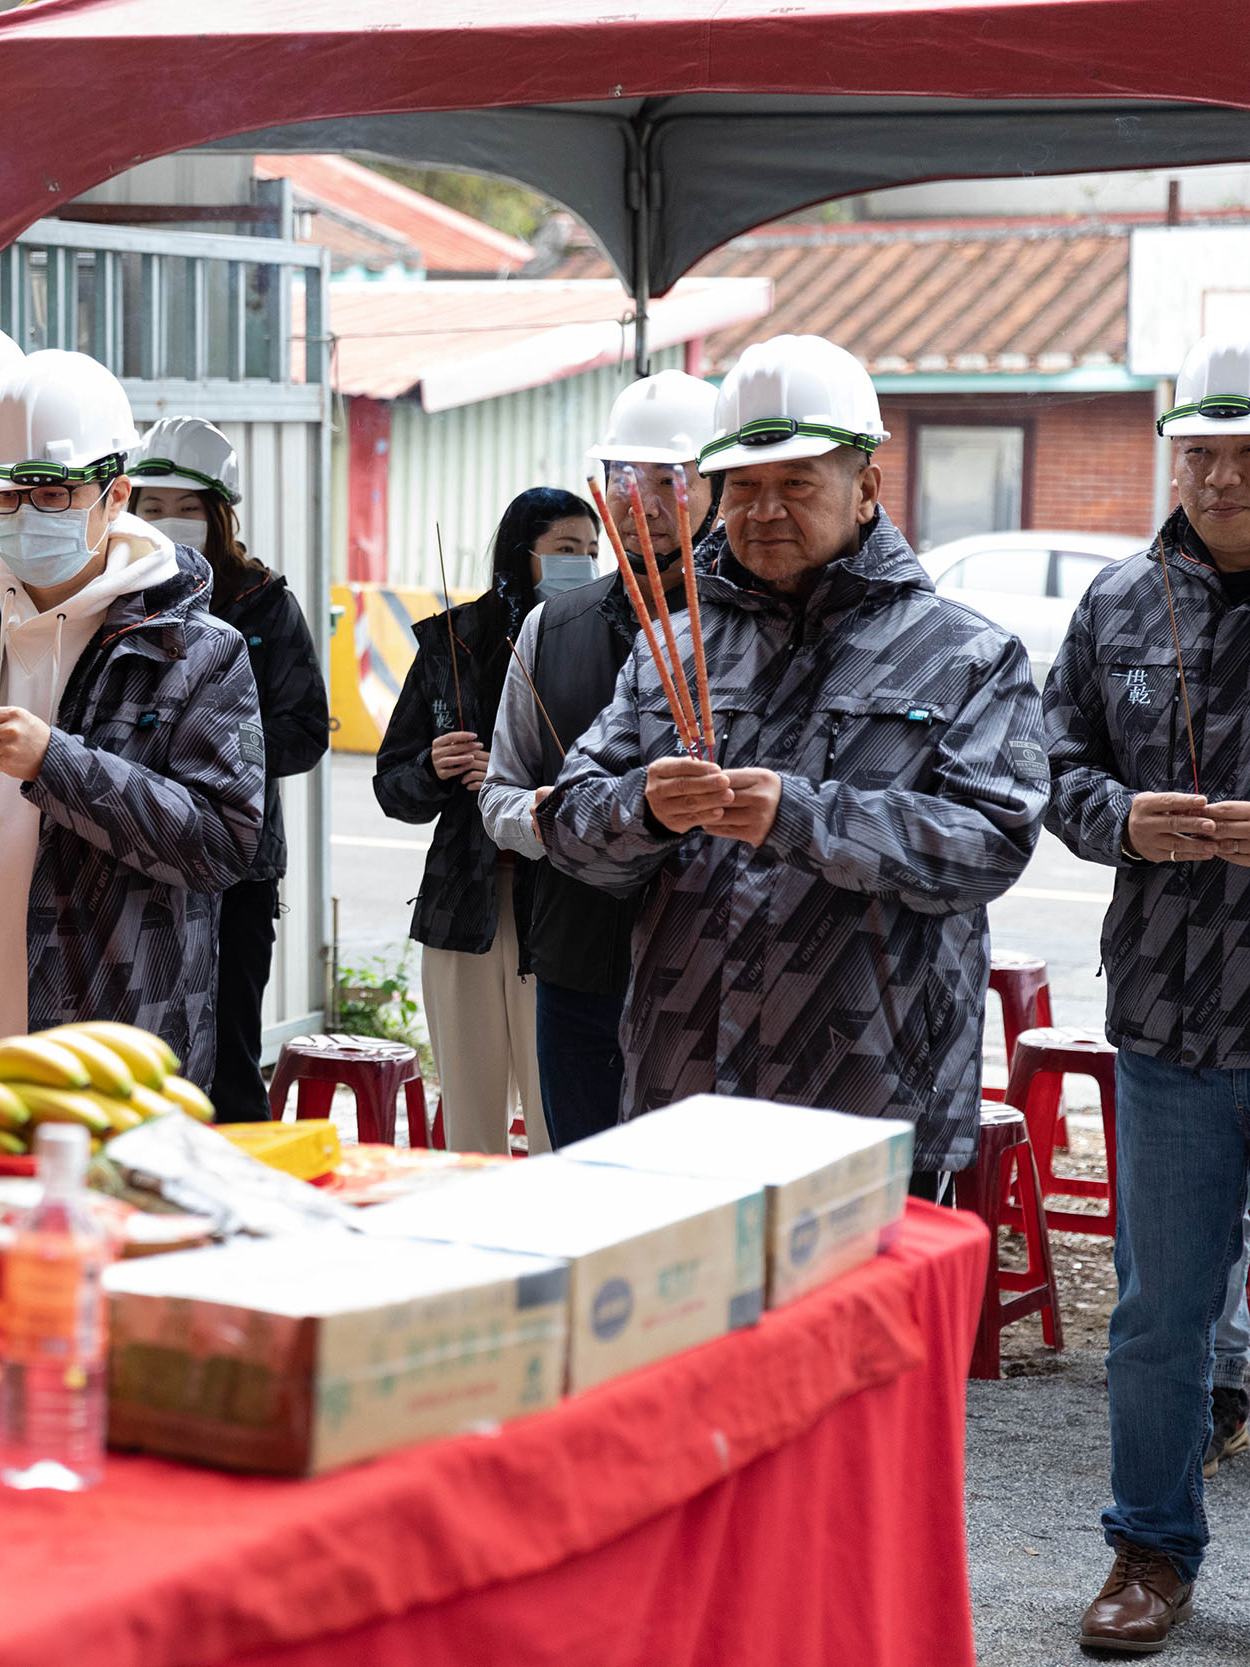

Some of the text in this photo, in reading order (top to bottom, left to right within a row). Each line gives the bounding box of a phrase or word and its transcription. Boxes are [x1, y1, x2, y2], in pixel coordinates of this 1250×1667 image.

[1111, 669, 1156, 705] 世乾
[802, 912, 835, 962] ONE BOY
[932, 1009, 947, 1037] ONE
[1196, 1001, 1214, 1024] ONE
